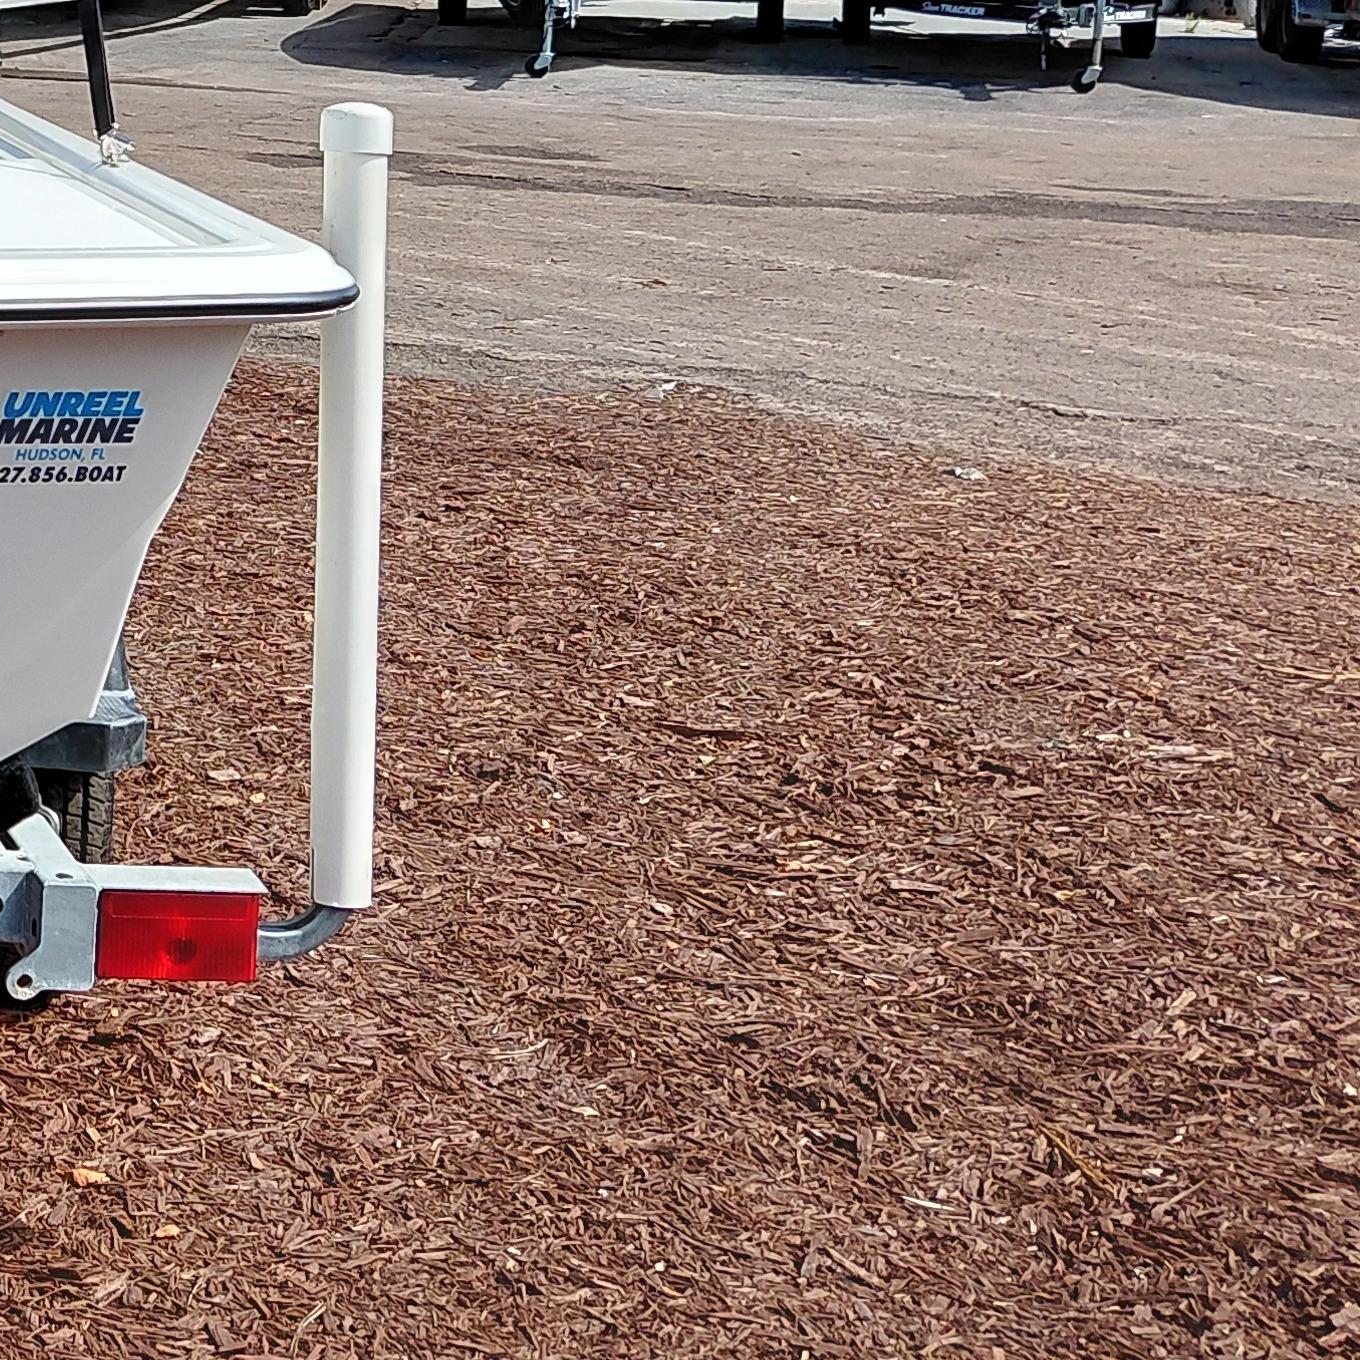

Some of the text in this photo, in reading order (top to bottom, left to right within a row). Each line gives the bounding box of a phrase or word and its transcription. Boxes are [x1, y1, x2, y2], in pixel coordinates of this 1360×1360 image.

[940, 3, 985, 16] TRACKER
[3, 390, 144, 418] UNREEL
[15, 448, 106, 462] HUDSON, FL
